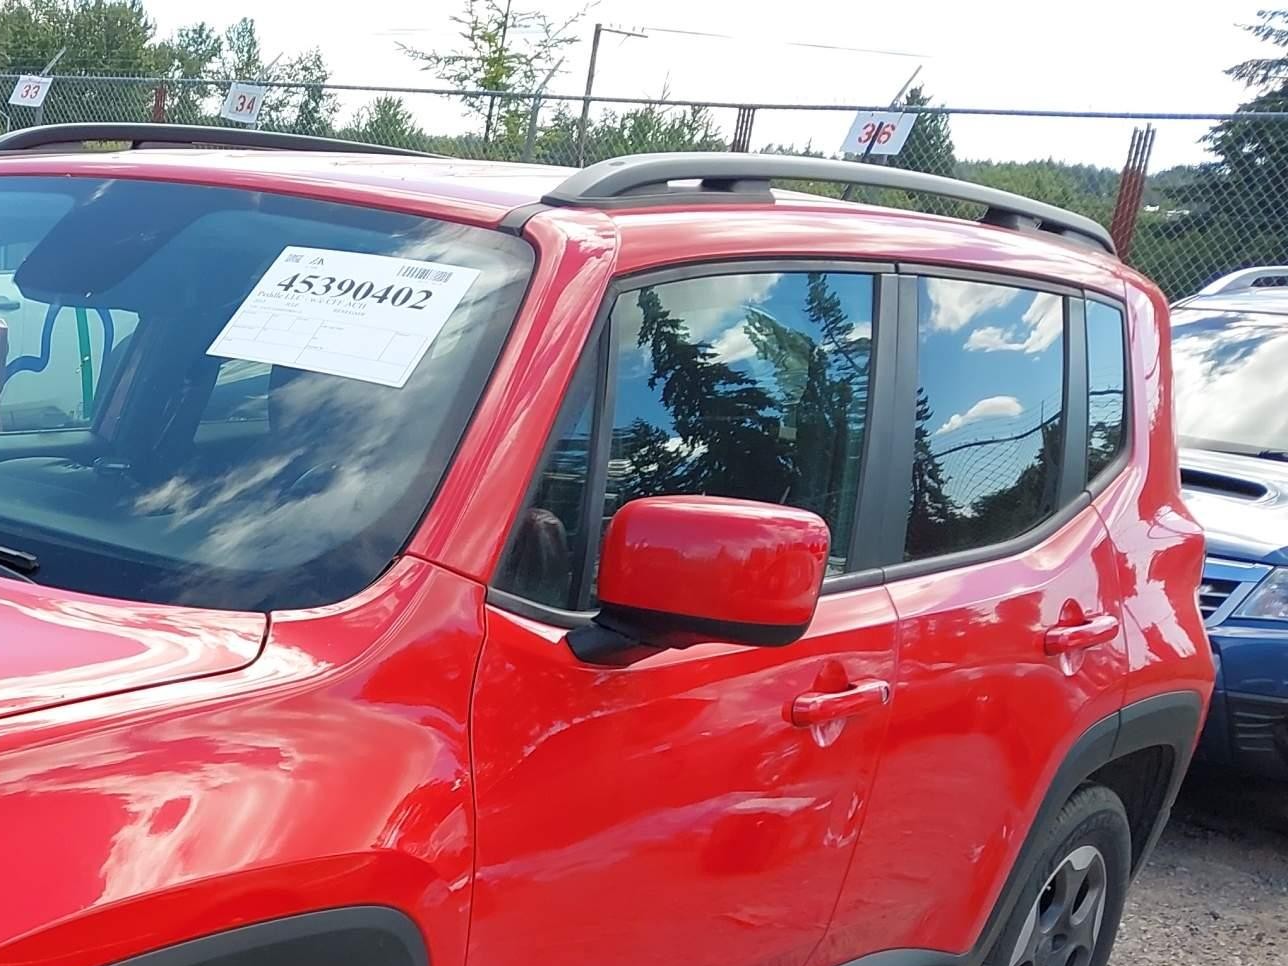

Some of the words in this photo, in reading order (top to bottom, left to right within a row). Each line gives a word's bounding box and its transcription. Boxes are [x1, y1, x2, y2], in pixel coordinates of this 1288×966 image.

[20, 83, 41, 99] 33
[235, 94, 257, 114] 34
[857, 122, 896, 145] 36
[276, 272, 433, 310] 45390402
